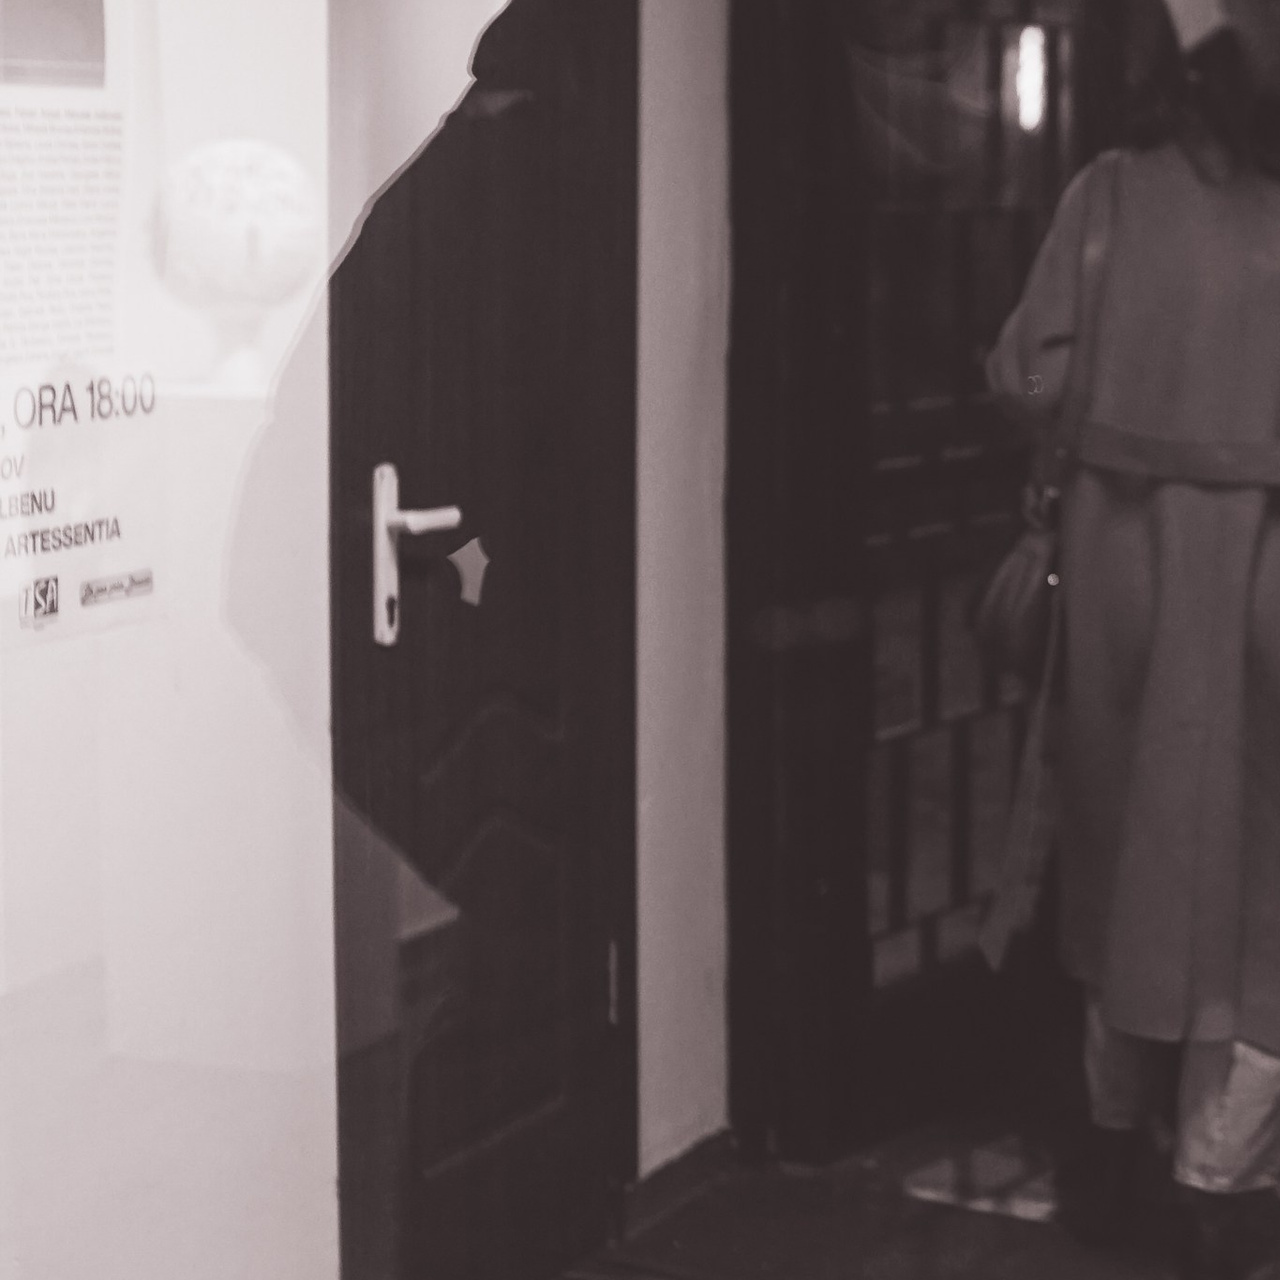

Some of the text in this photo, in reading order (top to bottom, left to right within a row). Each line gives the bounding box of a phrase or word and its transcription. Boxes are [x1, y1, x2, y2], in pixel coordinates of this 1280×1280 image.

[13, 372, 156, 429] ORA 18:00
[4, 515, 122, 558] ARTESSENTIA
